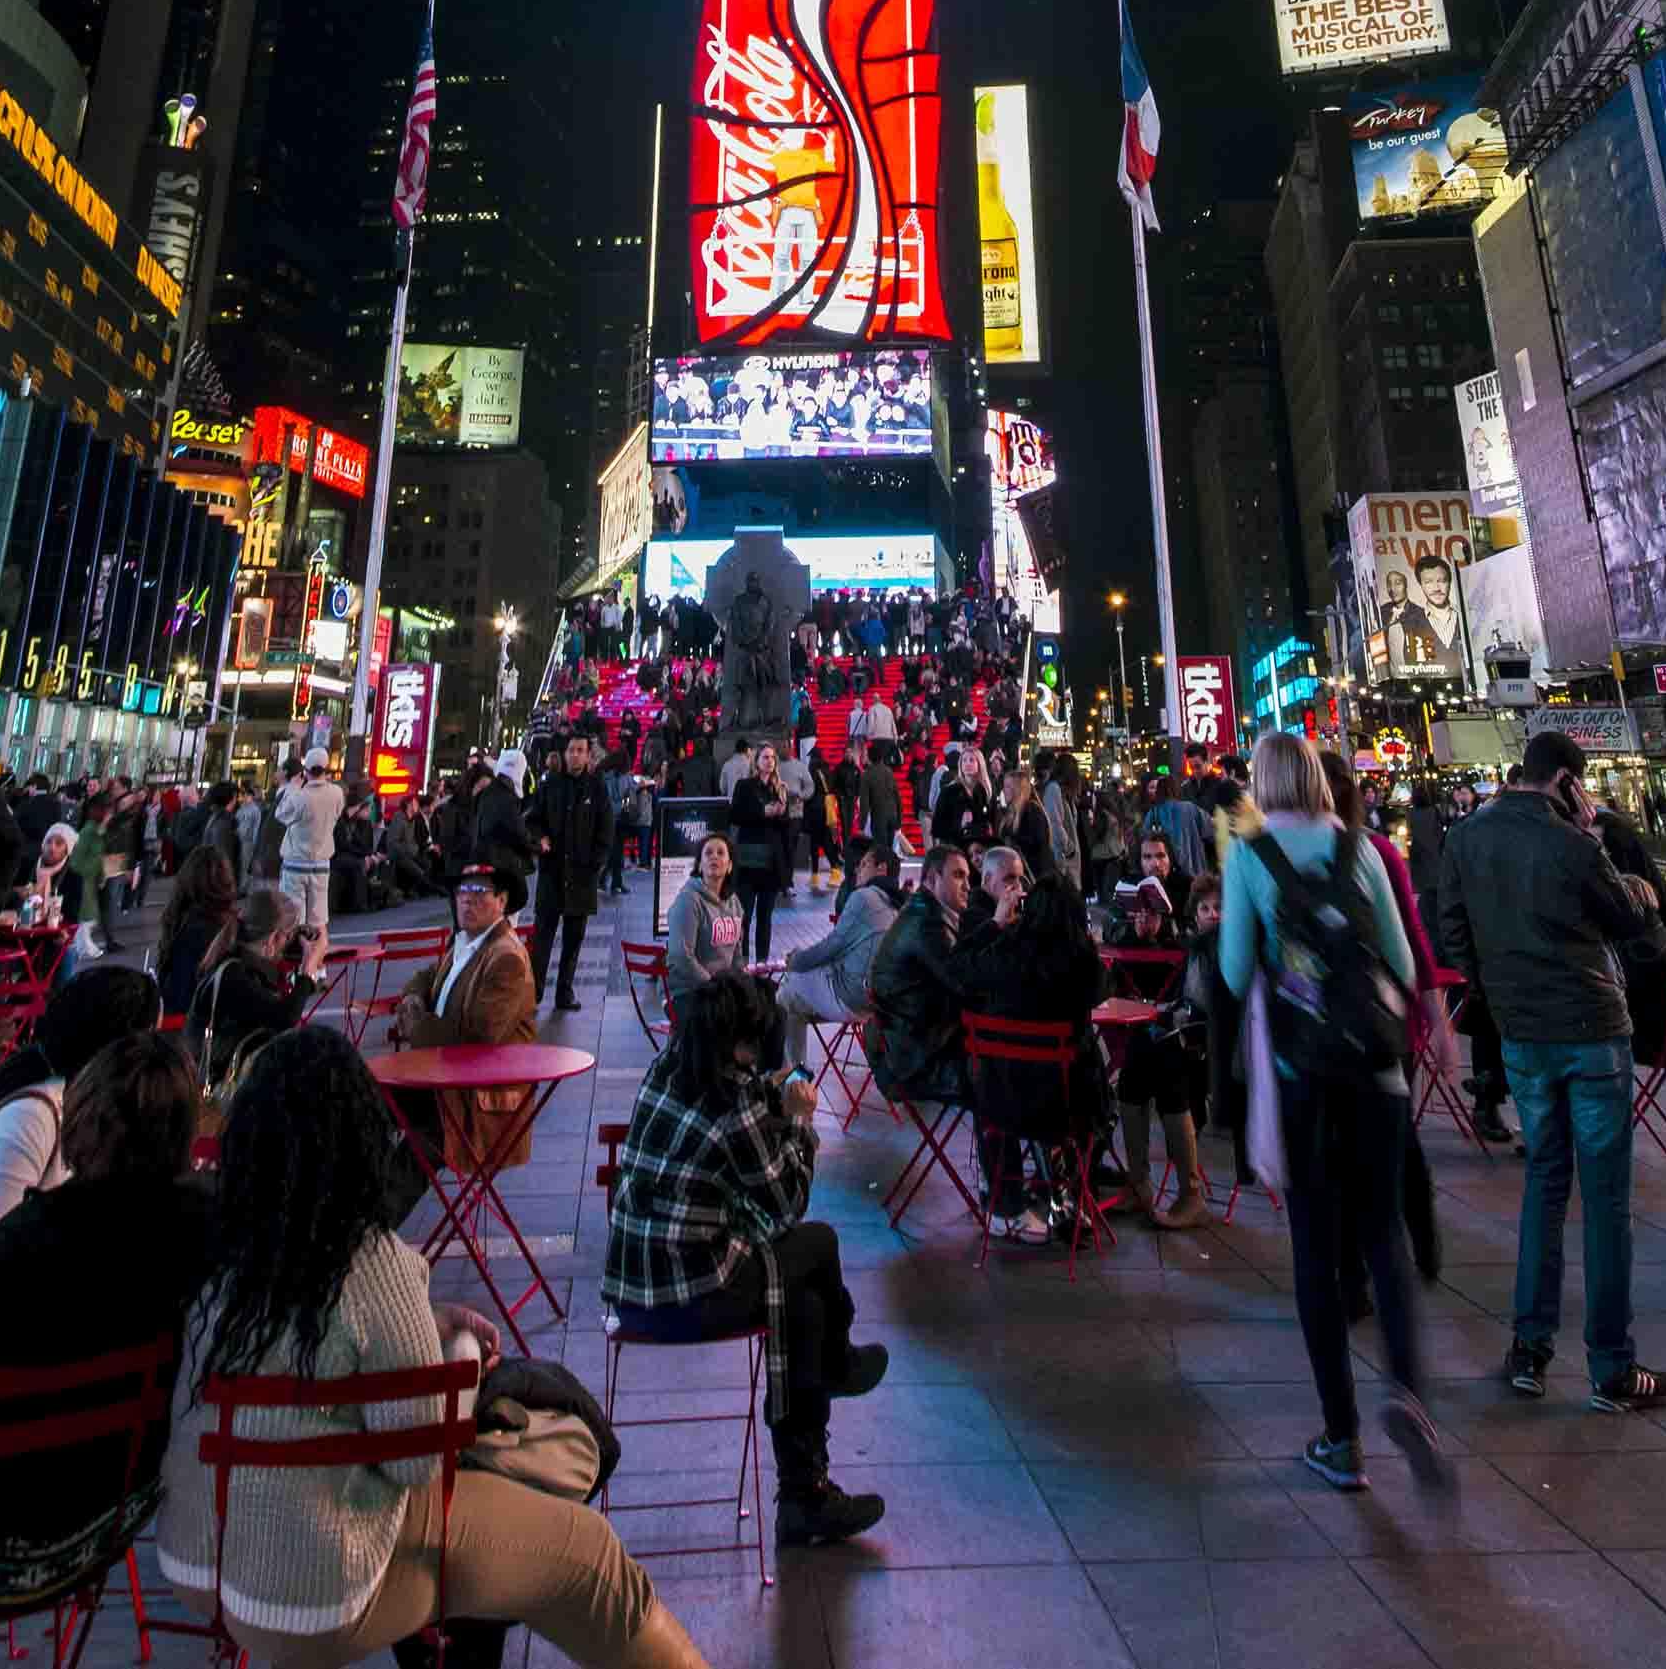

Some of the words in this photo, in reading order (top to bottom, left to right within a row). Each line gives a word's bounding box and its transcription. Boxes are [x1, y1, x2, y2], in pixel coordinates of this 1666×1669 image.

[1292, 15, 1395, 44] MUSICAL
[1400, 8, 1433, 26] OF
[1293, 40, 1338, 58] THIS
[1368, 138, 1384, 151] be
[1386, 135, 1405, 148] our
[1409, 128, 1441, 146] guest
[772, 355, 839, 370] HYUNDAI
[1466, 374, 1500, 403] START
[1477, 399, 1499, 422] THE
[171, 410, 244, 444] Reese's
[333, 454, 362, 477] PLAZA
[1370, 499, 1469, 533] men
[1374, 536, 1396, 556] at
[386, 672, 424, 748] tkts
[1184, 663, 1223, 745] tkts
[1539, 712, 1580, 726] GOING
[1582, 712, 1604, 725] OUT
